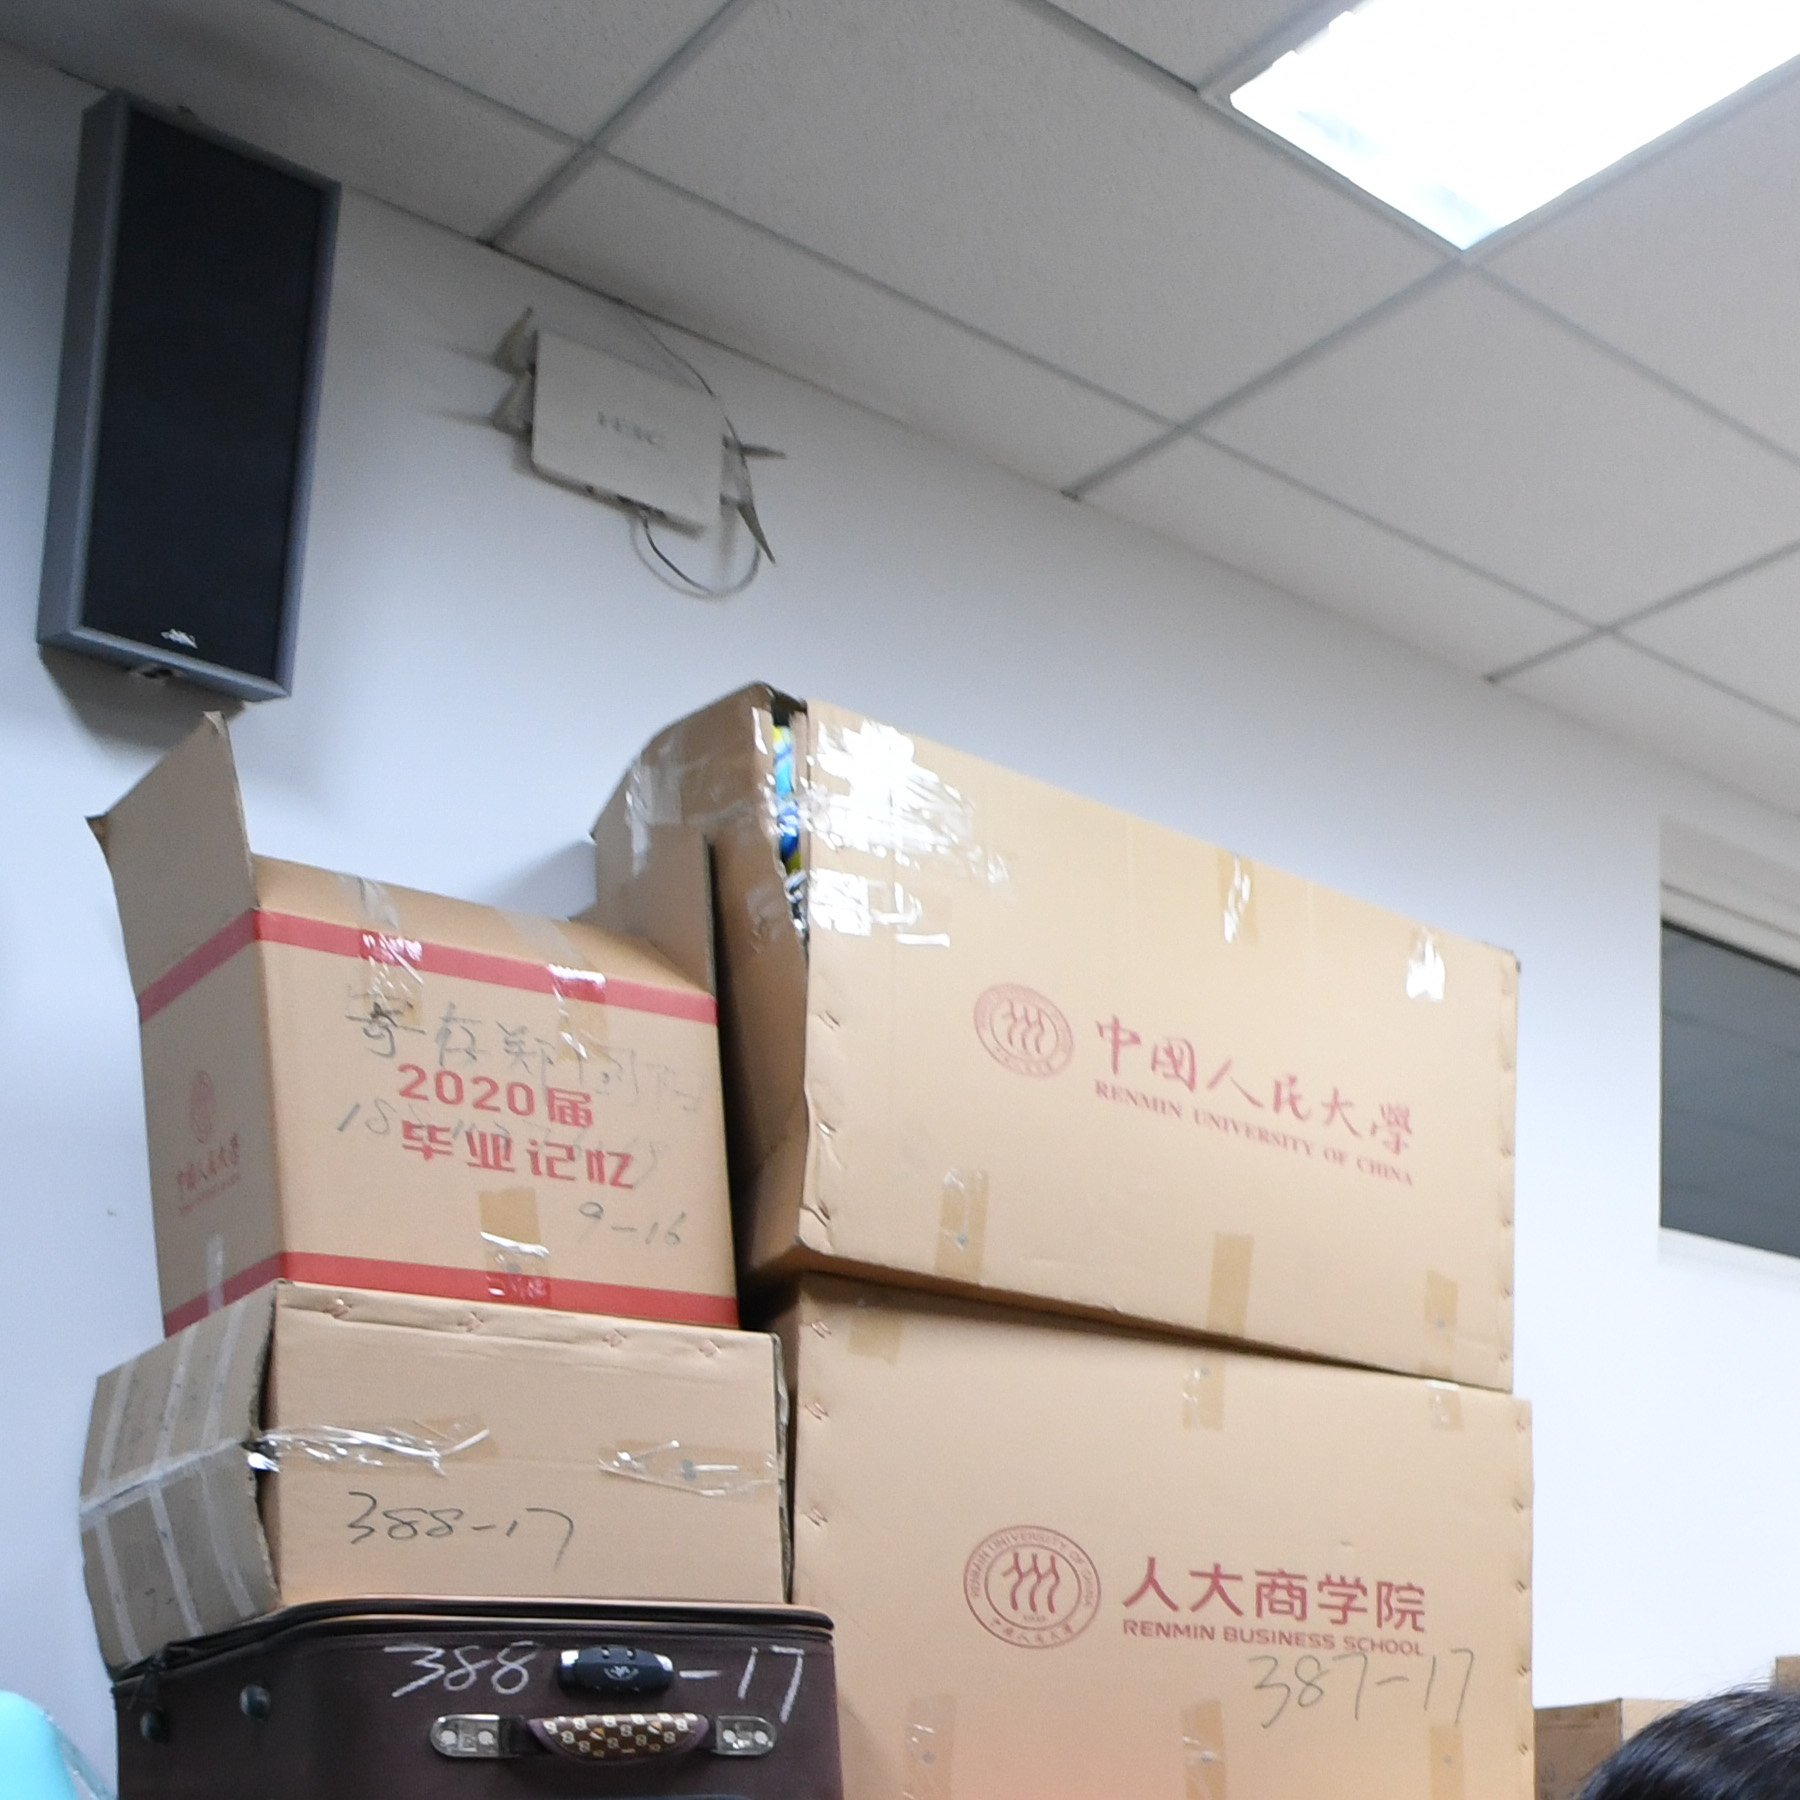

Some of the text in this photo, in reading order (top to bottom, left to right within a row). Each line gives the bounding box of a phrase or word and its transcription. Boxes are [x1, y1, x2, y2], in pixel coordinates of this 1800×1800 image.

[397, 1061, 597, 1131] 2020届
[1094, 1078, 1415, 1187] RENMIN UNIVERSITY OF CHINA
[400, 1119, 638, 1190] 毕业记忆
[348, 1491, 576, 1569] 388-17
[1122, 1556, 1427, 1635] 人大商学院
[1122, 1618, 1425, 1657] RENMIN BUSINESS SCHOOL
[1249, 1649, 1476, 1730] 387-17
